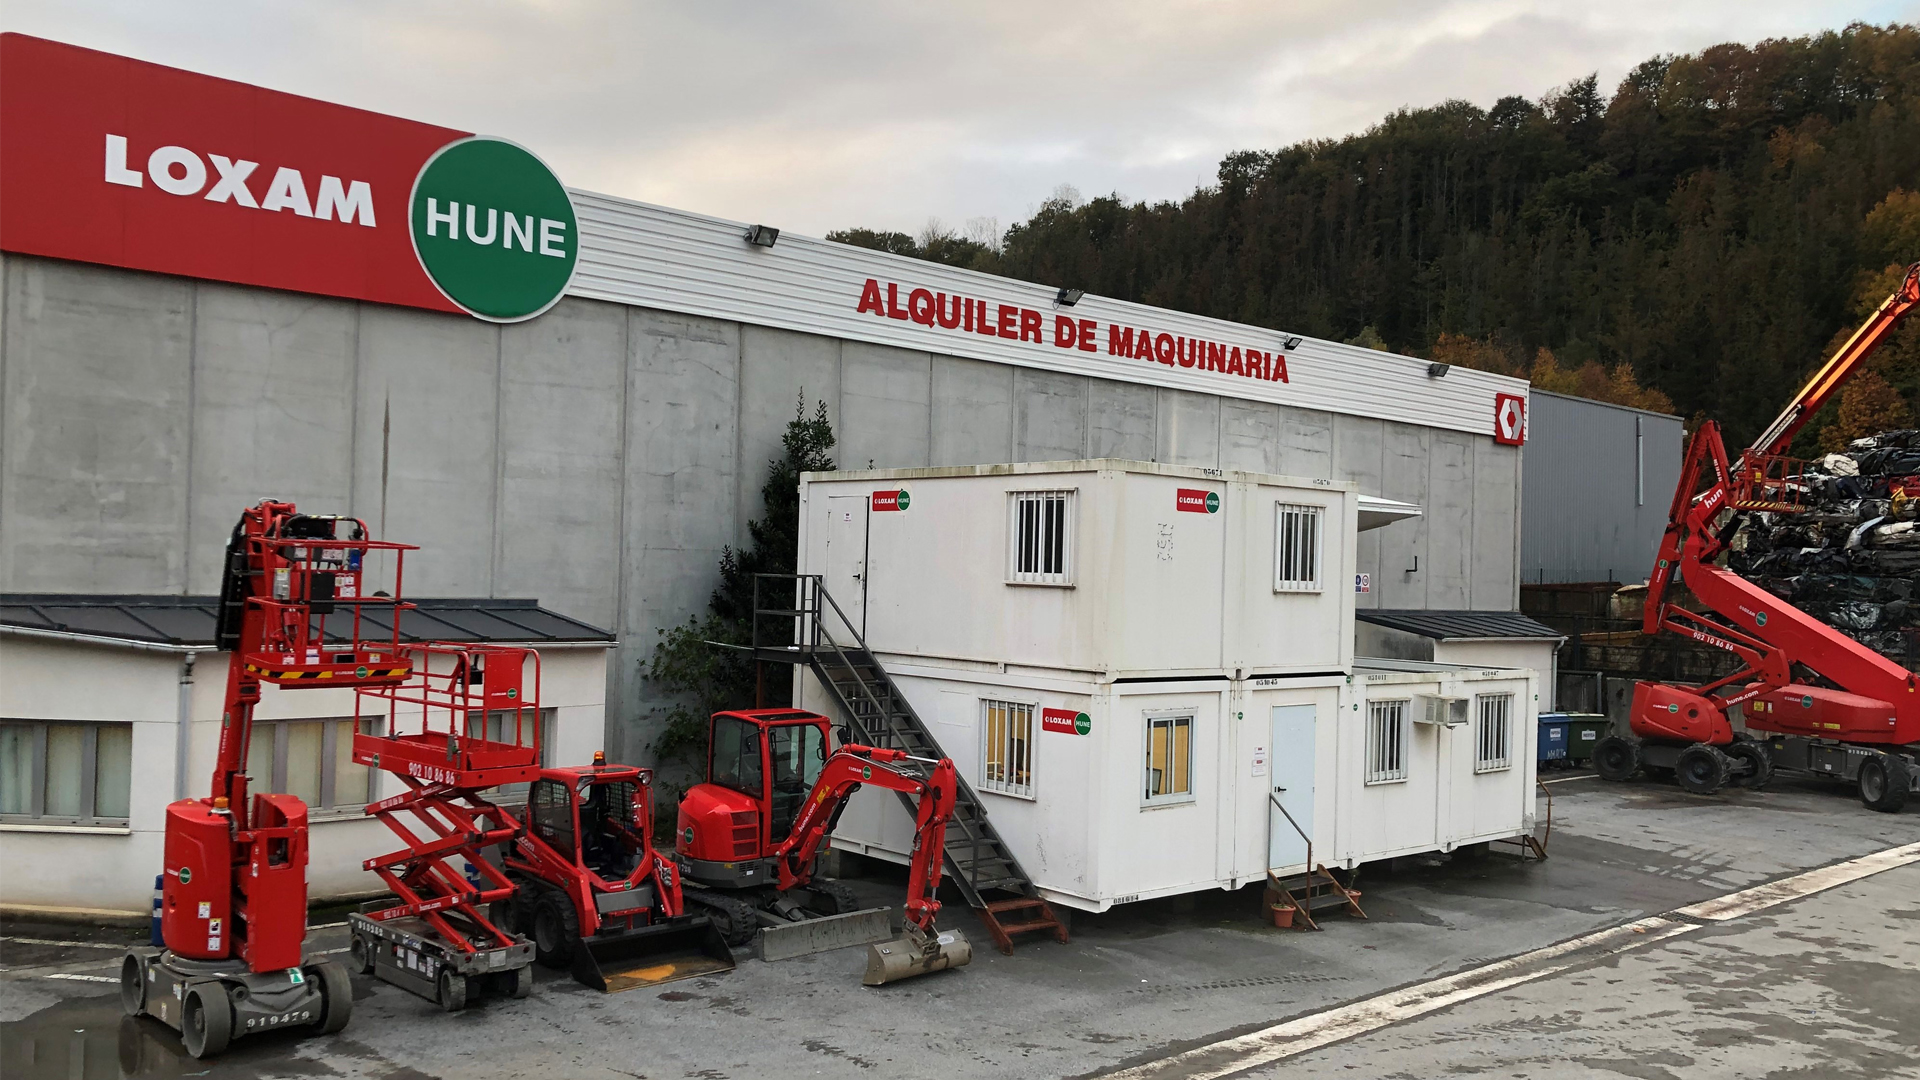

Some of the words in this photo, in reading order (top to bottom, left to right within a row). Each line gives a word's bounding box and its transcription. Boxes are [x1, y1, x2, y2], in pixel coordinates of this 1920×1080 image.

[105, 134, 376, 227] LOXAM
[427, 198, 567, 258] HUNE
[857, 278, 1042, 344] ALQUILER
[1055, 315, 1097, 352] DE
[1109, 324, 1289, 384] MAQUINARIA
[1183, 497, 1203, 505] LOXAM
[1693, 630, 1704, 641] 902
[1706, 636, 1714, 644] 10
[1715, 640, 1724, 648] 86
[1725, 643, 1734, 651] 86
[1726, 690, 1759, 705] hune.com
[1050, 717, 1072, 726] LOXAM
[1076, 720, 1090, 728] HUNE
[408, 762, 422, 776] 902
[424, 765, 433, 780] 10
[434, 768, 444, 783] 86
[445, 770, 455, 785] 86
[798, 803, 816, 832] hune.com
[247, 1011, 310, 1027] 919479
